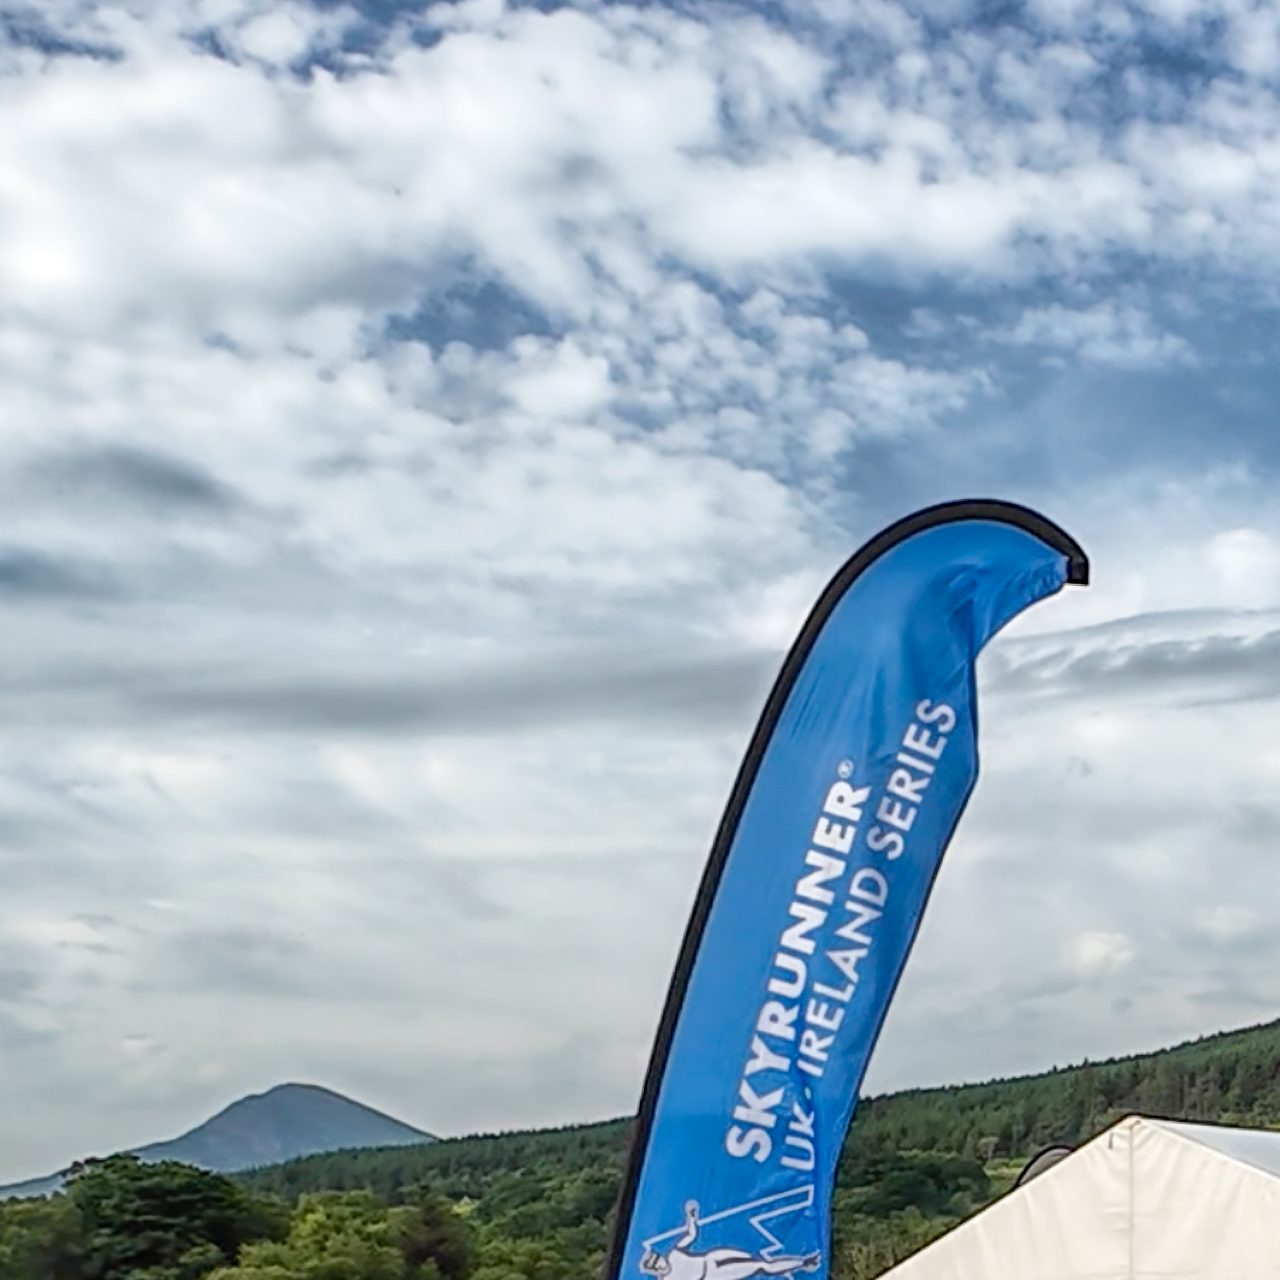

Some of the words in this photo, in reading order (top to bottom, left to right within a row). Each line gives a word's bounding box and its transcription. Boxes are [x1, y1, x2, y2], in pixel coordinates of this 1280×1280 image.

[867, 699, 956, 861] SERIES
[797, 867, 888, 1078] IRELAND
[781, 1102, 815, 1171] UK
